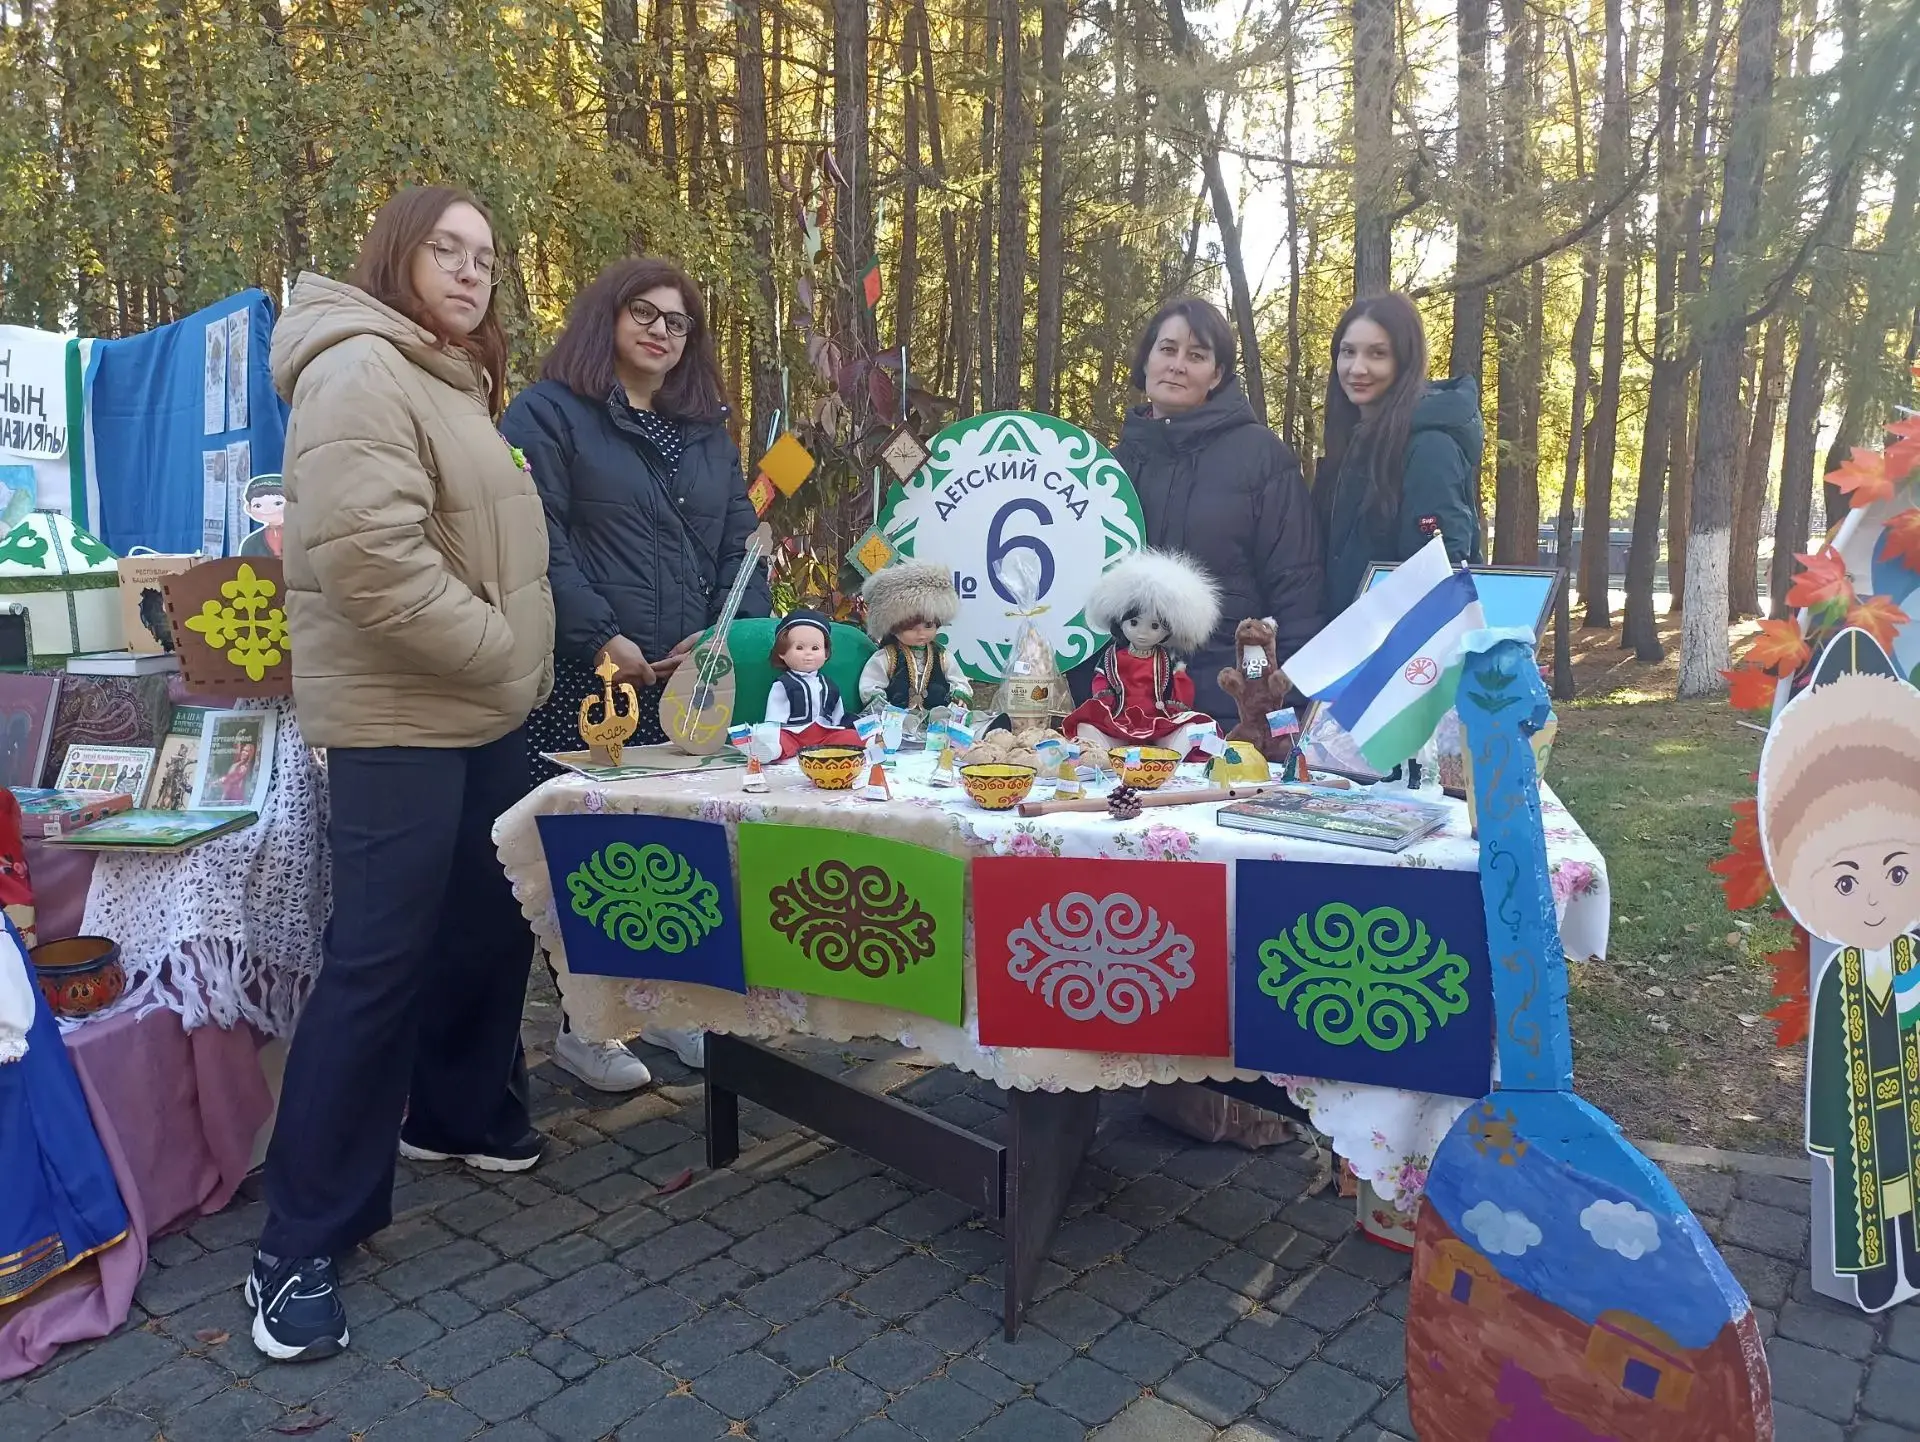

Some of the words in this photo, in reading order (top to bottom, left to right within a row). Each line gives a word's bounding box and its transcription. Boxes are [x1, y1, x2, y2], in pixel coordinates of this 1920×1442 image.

[934, 458, 1037, 522] ДЕТСКИЙ
[1043, 471, 1089, 521] САД
[135, 568, 172, 576] РЕСПУБЛИК
[986, 498, 1055, 605] 6
